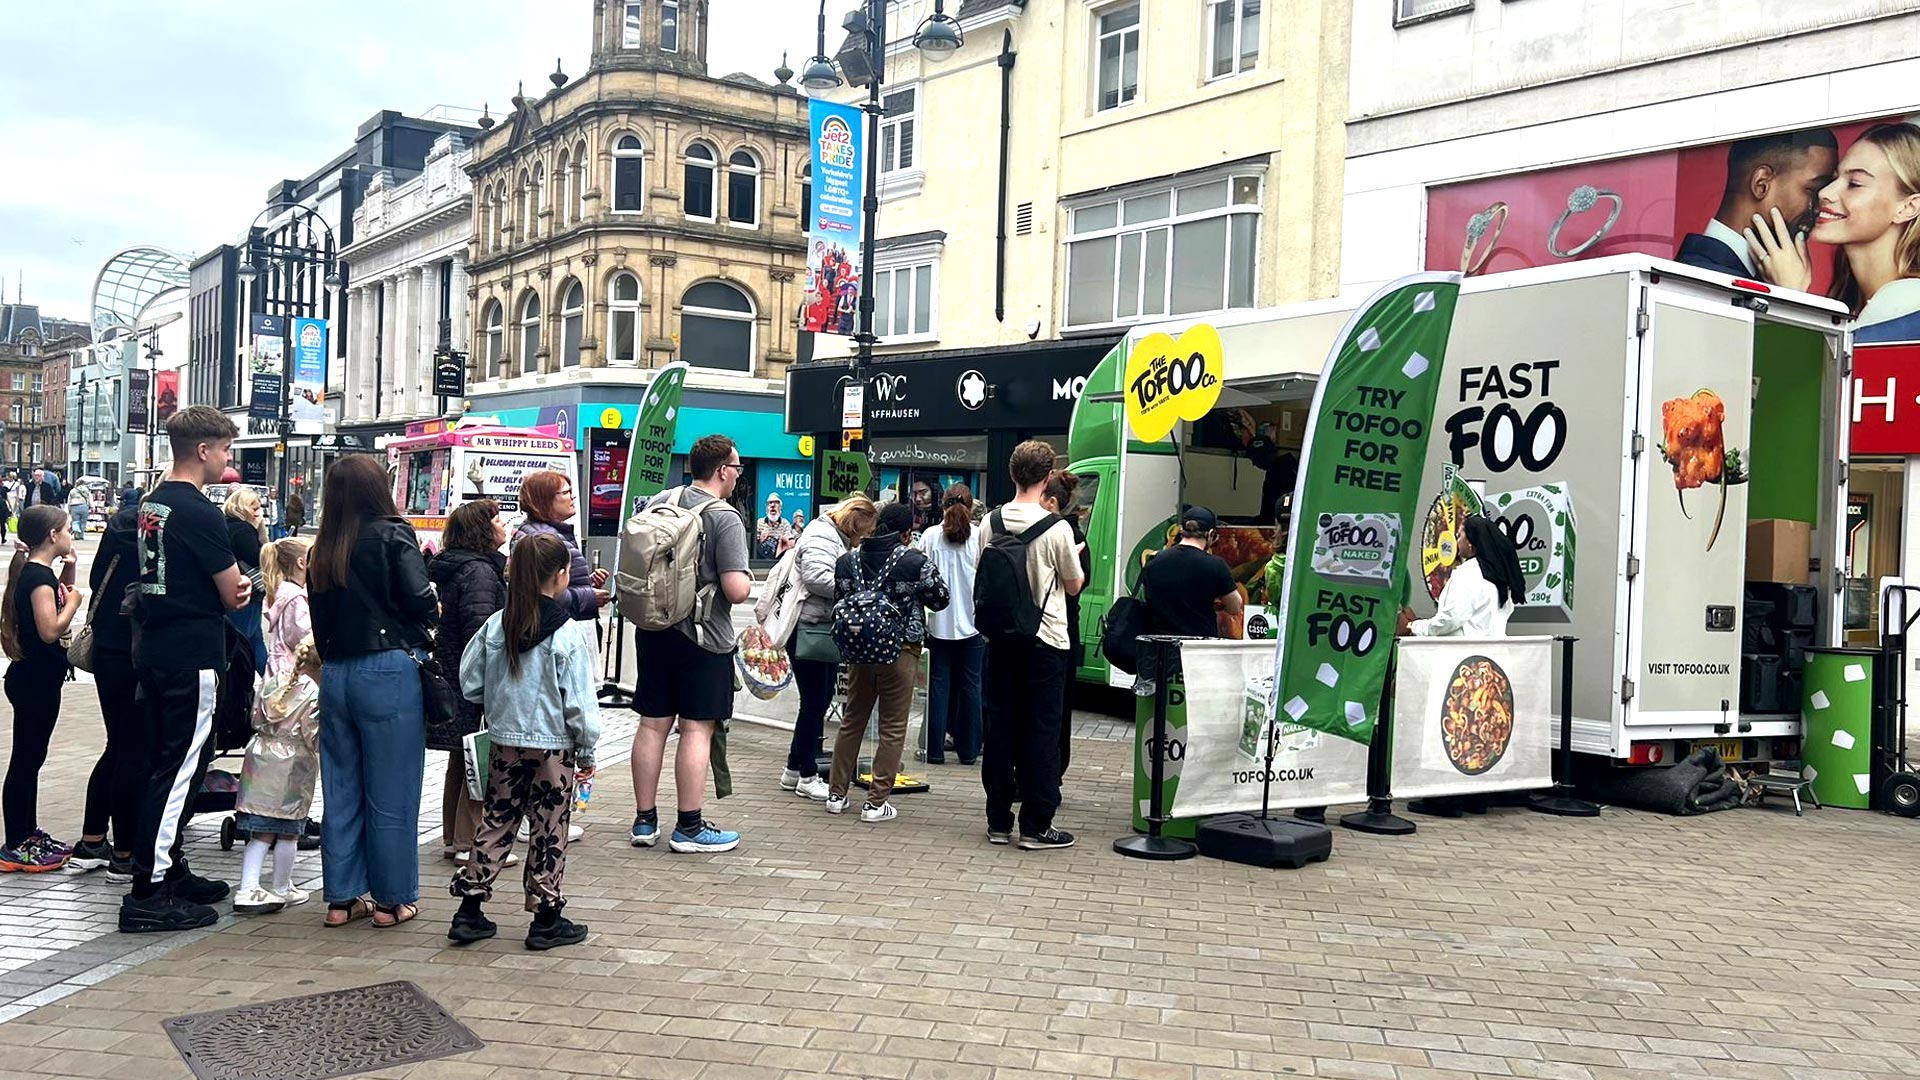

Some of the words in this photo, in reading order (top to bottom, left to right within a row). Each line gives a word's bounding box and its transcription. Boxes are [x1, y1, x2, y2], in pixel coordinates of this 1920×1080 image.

[823, 129, 850, 144] jet2
[820, 140, 853, 156] TAKES
[821, 152, 852, 167] PRIDE
[1149, 355, 1167, 372] THE
[869, 375, 907, 401] WC
[1052, 376, 1087, 400] MO
[1459, 360, 1560, 402] FAST
[1357, 385, 1408, 410] TRY
[607, 415, 615, 425] E
[1332, 409, 1423, 440] TOFOO
[649, 425, 667, 438] TRY
[1444, 401, 1567, 473] FOO
[477, 438, 491, 446] MR
[493, 439, 529, 448] WHIPPY
[530, 441, 559, 449] LEEDS
[804, 440, 811, 451] E
[1344, 439, 1399, 465] FOR
[485, 458, 516, 467] DELICIOUS
[644, 454, 664, 468] FOR
[640, 469, 665, 484] FREE
[775, 473, 794, 489] NEW
[794, 473, 804, 489] EE
[827, 470, 859, 493] Taste
[1334, 464, 1403, 493] FREE
[1456, 481, 1465, 492] TO
[1526, 490, 1545, 502] EXTRA
[1543, 499, 1555, 514] FIRM
[1343, 550, 1379, 560] NAKED
[1316, 589, 1381, 618] FAST
[1531, 593, 1552, 603] 280g
[1248, 624, 1269, 634] taste
[1306, 612, 1378, 657] FOO
[1648, 663, 1671, 674] VISIT
[1672, 663, 1730, 675] TOFOO.CO.UK
